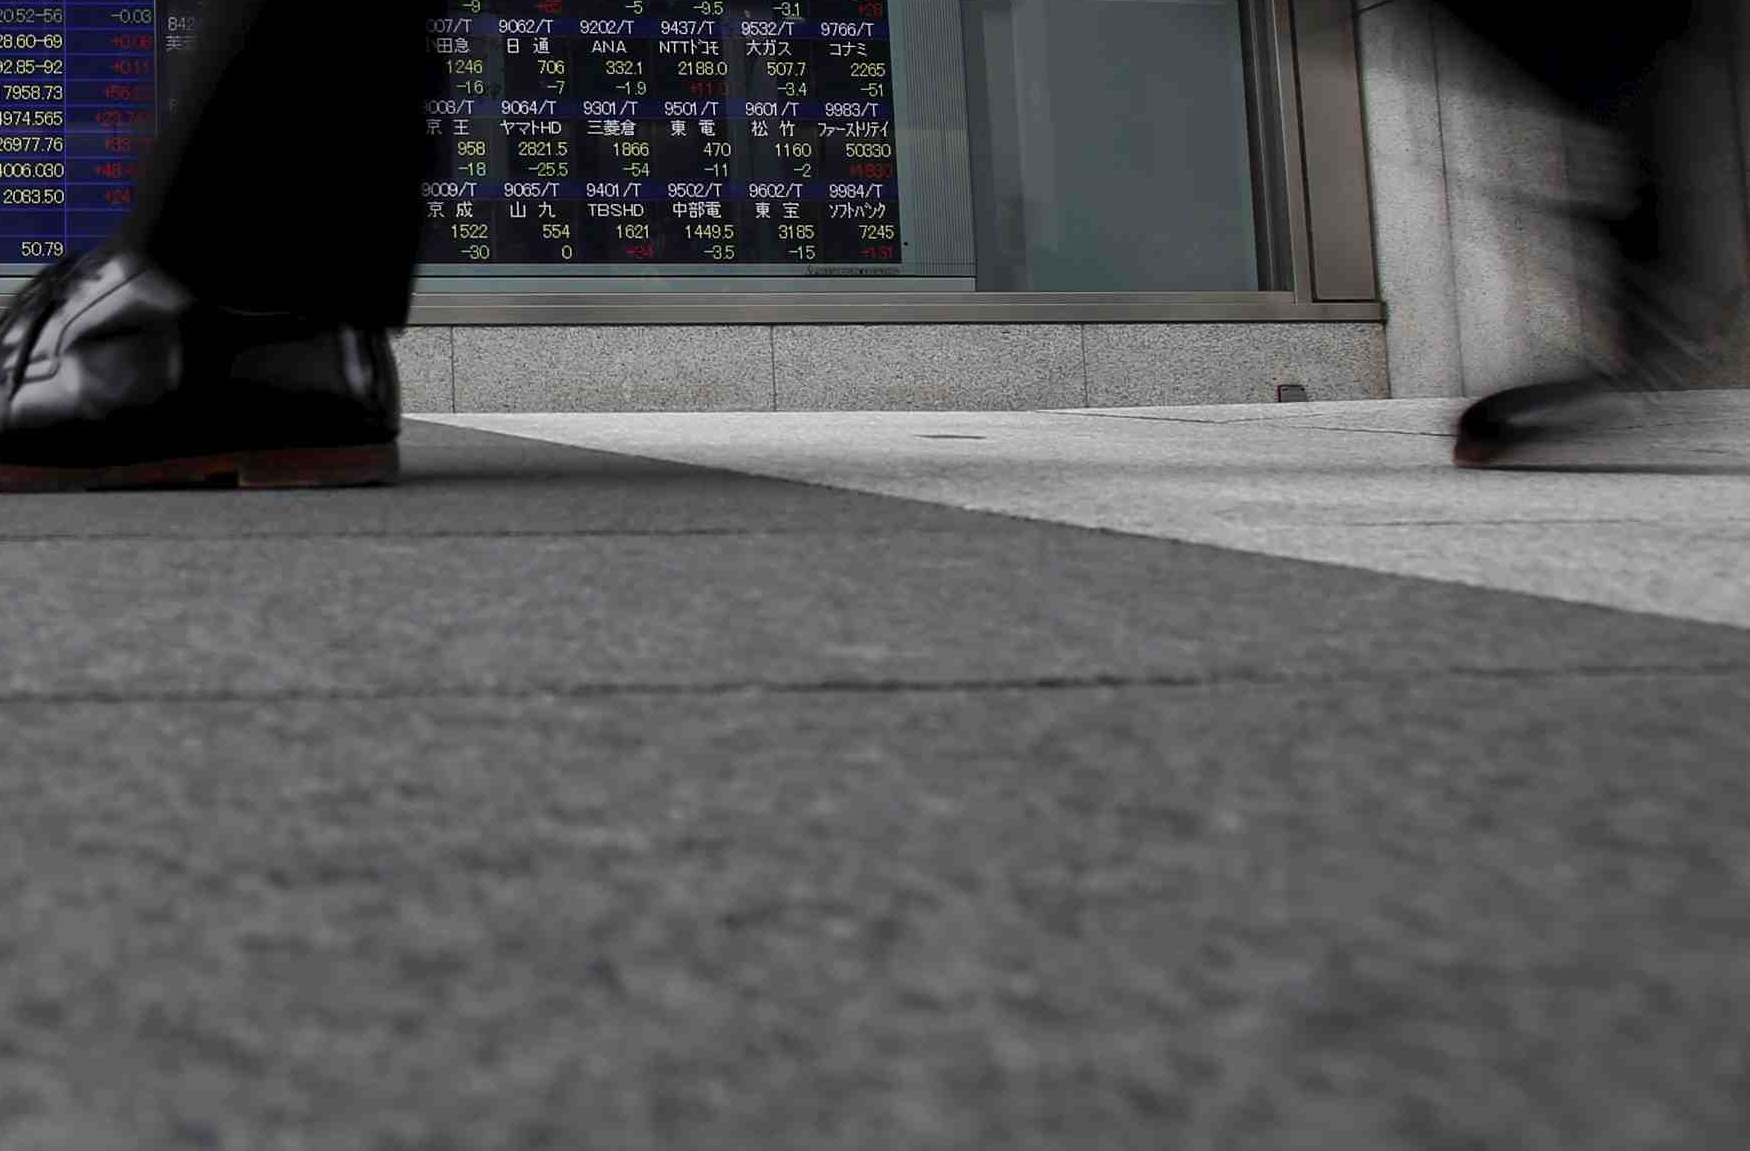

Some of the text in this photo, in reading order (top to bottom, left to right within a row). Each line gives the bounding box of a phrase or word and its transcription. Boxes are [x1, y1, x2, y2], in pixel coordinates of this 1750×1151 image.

[499, 19, 554, 33] 9062/T
[580, 20, 634, 34] 9202/T
[661, 21, 714, 36] 9437/T
[741, 21, 795, 36] 9532/T
[820, 22, 874, 37] 9766/T
[592, 41, 627, 53] ANA
[659, 40, 720, 55] NTTドコモ
[746, 40, 792, 55] 大ガス
[828, 41, 867, 57] コナミ
[501, 100, 557, 115] 9064/T
[583, 100, 638, 115] 9301/T
[664, 101, 719, 116] 9501/T
[745, 101, 799, 116] 9601/T
[825, 102, 880, 117] 9983/T
[499, 119, 562, 136] ヤマトHD
[587, 120, 636, 136] 三菱倉
[504, 182, 560, 197] 9065/T
[586, 182, 642, 197] 9401/T
[668, 183, 722, 197] 9502/T
[749, 183, 803, 198] 9602/T
[829, 184, 883, 198] 9984/T
[588, 203, 644, 217] TBSHD
[673, 202, 722, 219] 中部電
[22, 242, 63, 256] 50.79
